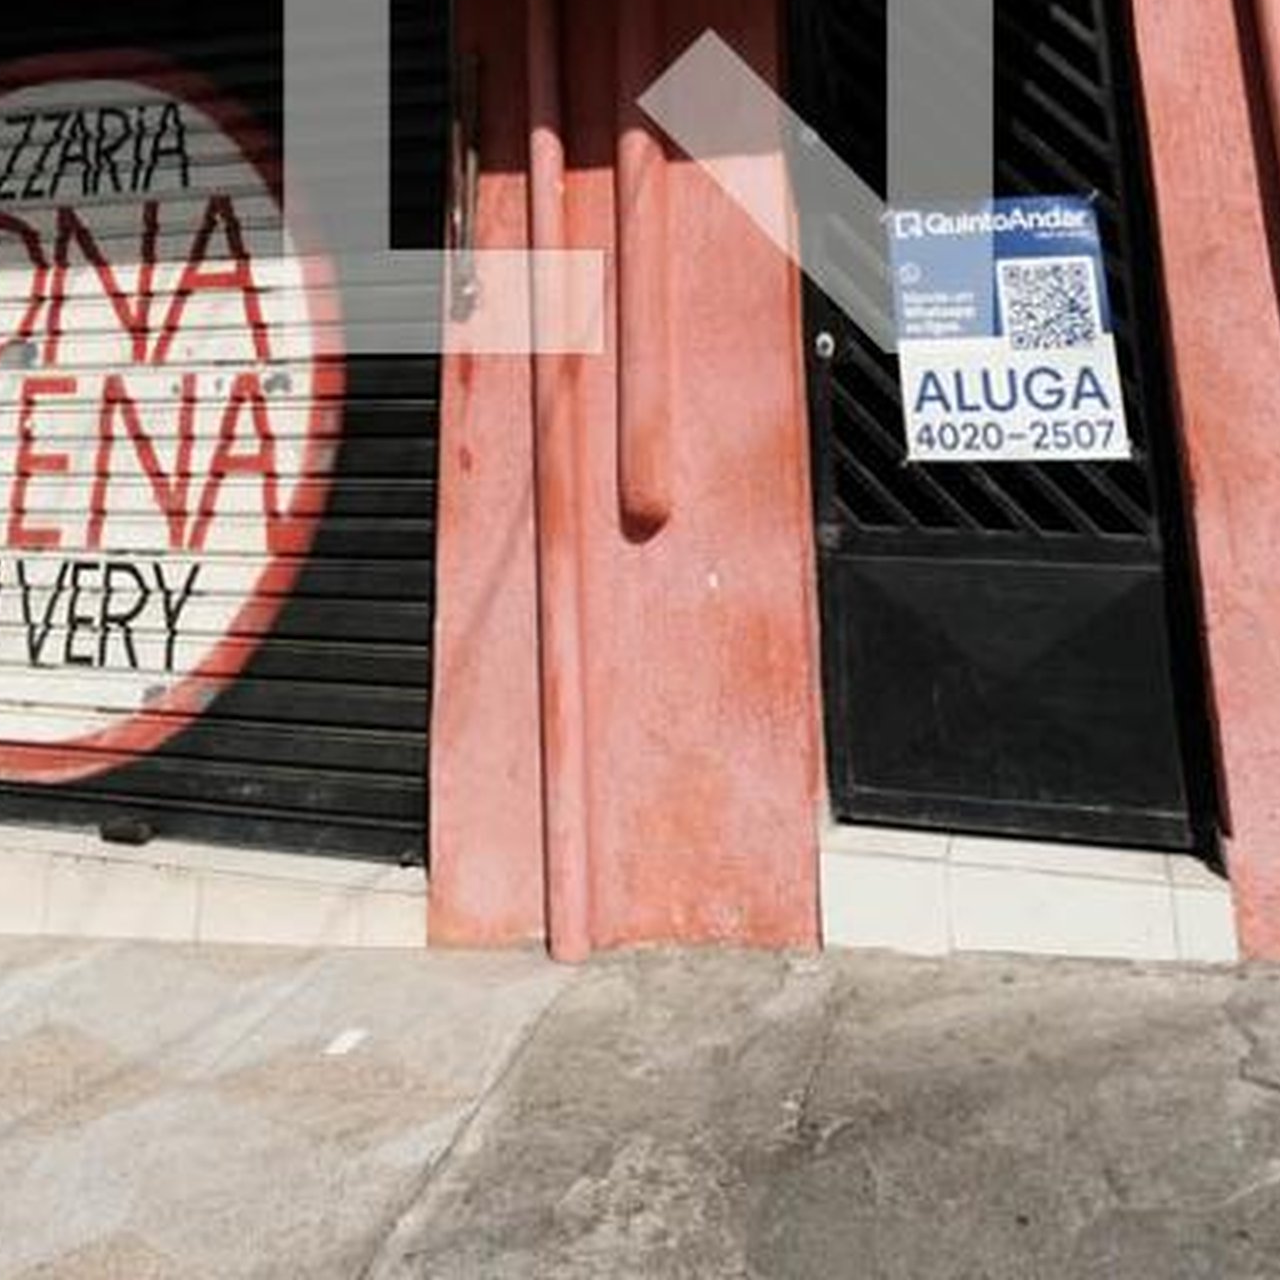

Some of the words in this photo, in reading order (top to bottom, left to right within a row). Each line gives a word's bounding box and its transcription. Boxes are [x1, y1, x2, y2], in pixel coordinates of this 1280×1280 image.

[925, 207, 1086, 236] QuintoAndar
[914, 367, 1110, 413] ALUGA
[916, 420, 1115, 451] 4020-2507
